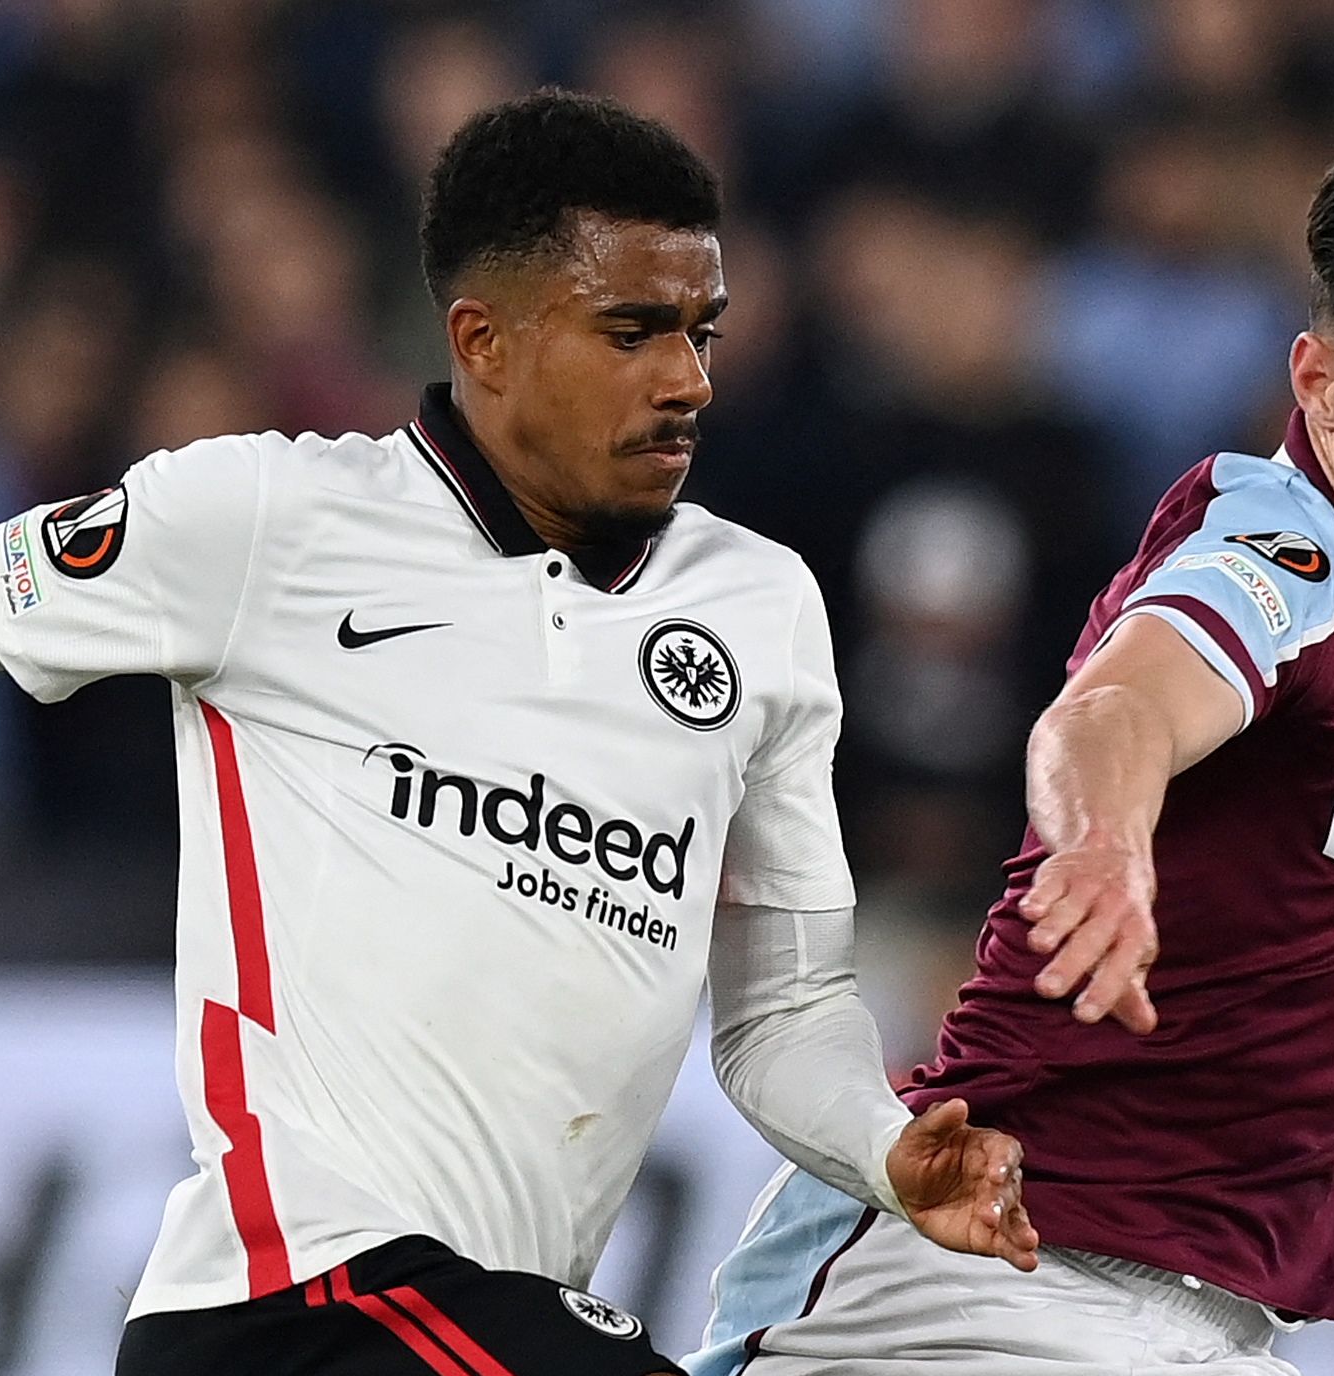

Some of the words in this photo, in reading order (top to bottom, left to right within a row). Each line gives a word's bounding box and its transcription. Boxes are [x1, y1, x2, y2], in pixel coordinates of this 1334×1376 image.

[8, 517, 37, 610] NDATION
[364, 744, 695, 900] indeed
[497, 862, 577, 912] Jobs
[585, 887, 678, 951] finden
